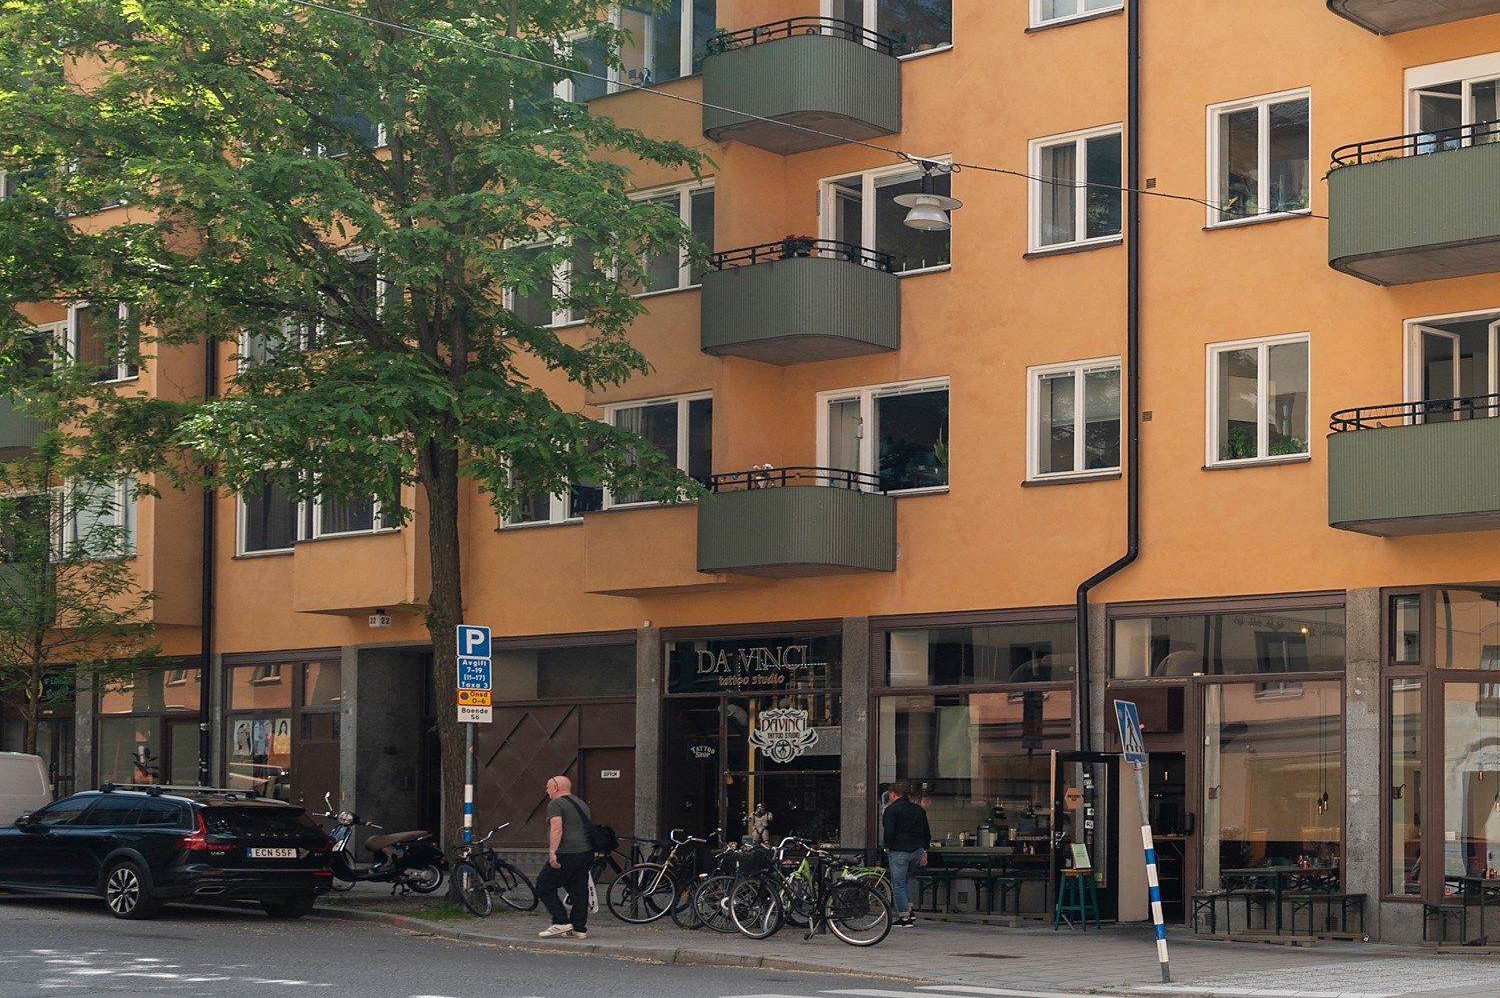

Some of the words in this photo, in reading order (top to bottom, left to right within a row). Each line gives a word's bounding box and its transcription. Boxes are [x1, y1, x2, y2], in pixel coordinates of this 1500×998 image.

[466, 629, 485, 654] P
[462, 659, 487, 667] Avgift
[697, 649, 731, 673] DA
[738, 645, 808, 671] VINCI
[719, 675, 749, 686] tattoo
[751, 673, 785, 685] studio
[255, 849, 273, 857] ECN
[275, 849, 293, 857] 55F
